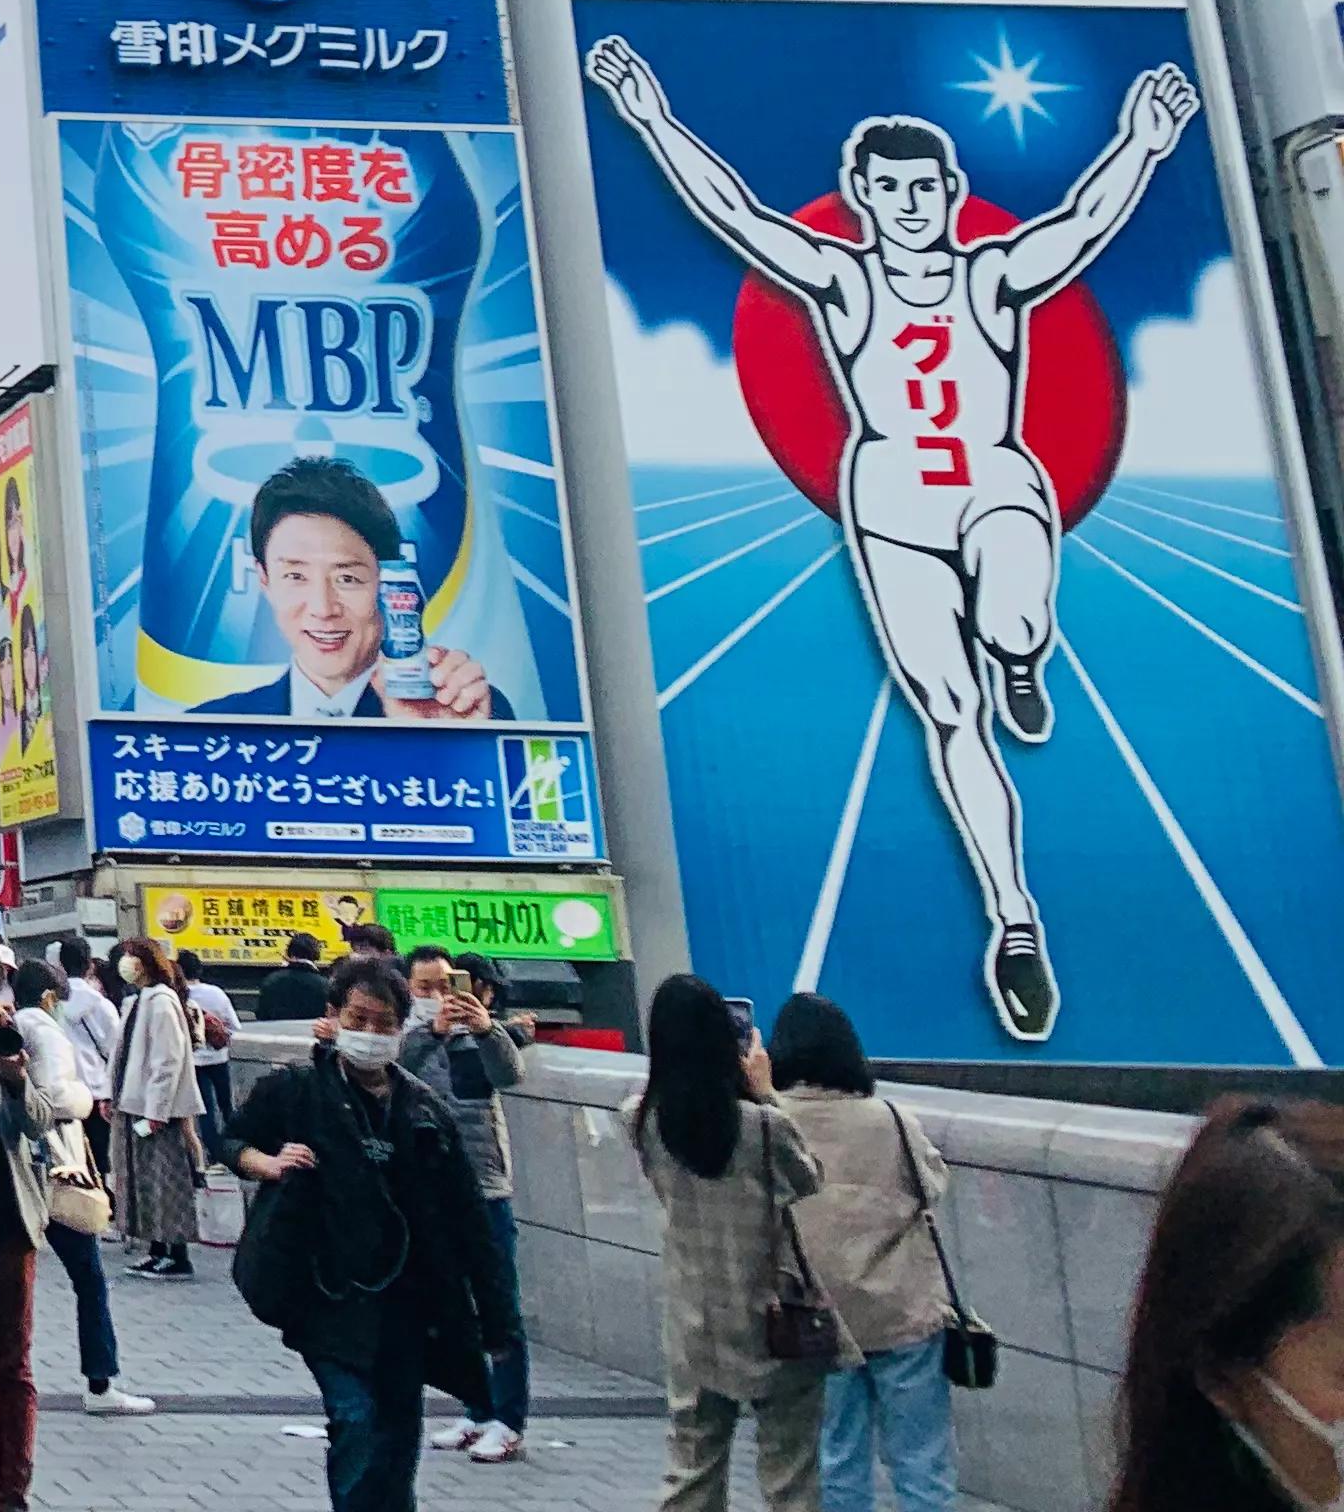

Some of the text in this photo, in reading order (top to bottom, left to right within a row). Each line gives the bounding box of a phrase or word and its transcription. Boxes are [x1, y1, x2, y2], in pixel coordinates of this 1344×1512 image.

[109, 18, 449, 72] 雪印メグミルク
[175, 140, 414, 204] 骨密度を
[205, 210, 394, 272] 高める
[190, 295, 424, 414] MBP
[891, 313, 972, 489] グリコ
[113, 733, 322, 761] スキージャンプ
[149, 819, 247, 837] 雪印メグミルク
